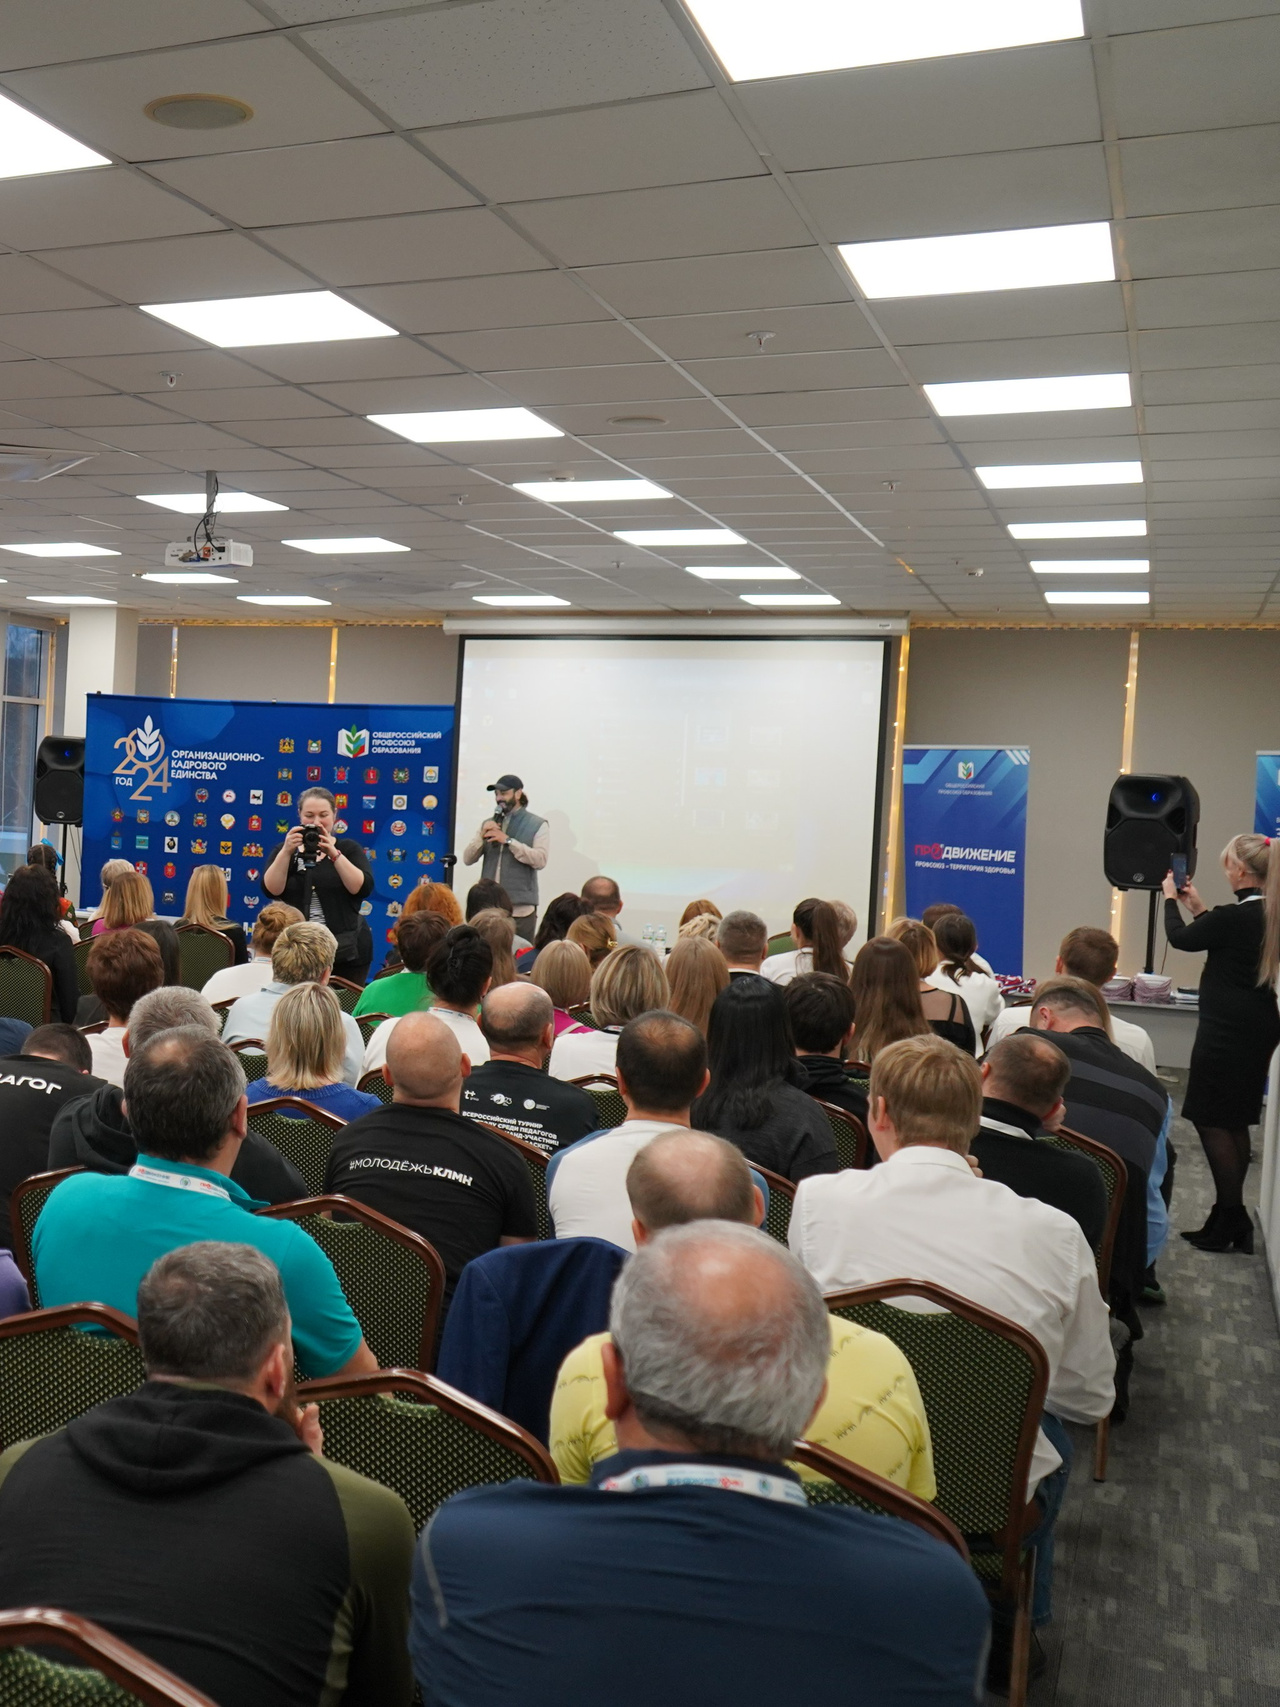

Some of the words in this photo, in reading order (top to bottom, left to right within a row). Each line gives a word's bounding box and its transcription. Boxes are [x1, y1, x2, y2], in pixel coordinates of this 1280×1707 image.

[372, 731, 442, 739] ОБЩЕРОССИЙСКИЙ
[372, 739, 416, 747] ПРОФСОЮЗ
[171, 750, 265, 763] ОРГАНИЗАЦИОННО-
[171, 760, 227, 771] КАДРОВОГО
[171, 770, 218, 780] ЕДИНСТВА
[115, 777, 133, 787] ГОД
[915, 861, 945, 869] ПРОФСОЮЗ
[950, 863, 984, 872] ТЕРРИТОРИЯ
[984, 867, 1016, 875] ЗДОРОВЬЯ
[462, 1111, 517, 1125] ВСЕРОССИЙСКИЙ
[518, 1120, 543, 1129] ТУРНИР
[497, 1123, 519, 1132] СРЕДИ
[520, 1127, 558, 1140] ПЕДАГОГОВ
